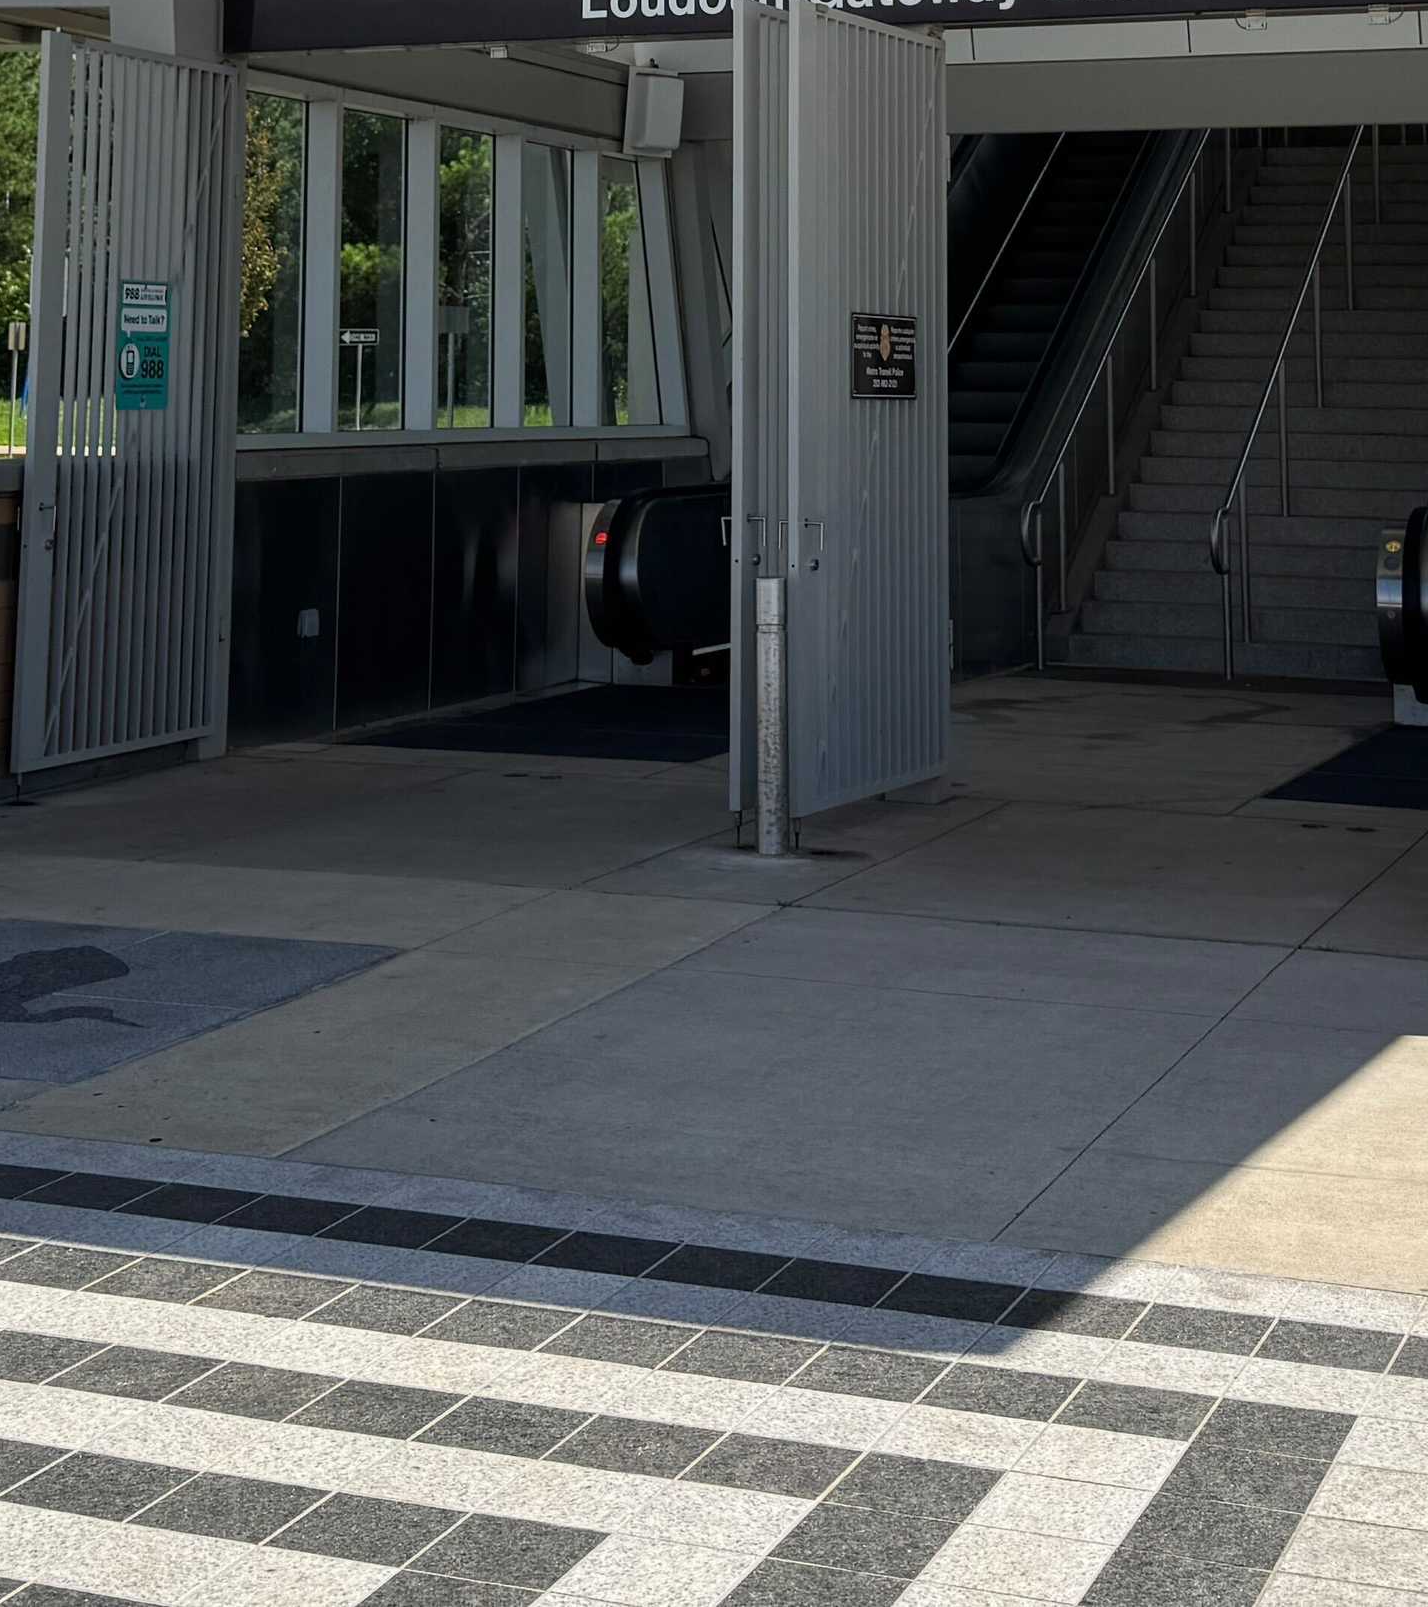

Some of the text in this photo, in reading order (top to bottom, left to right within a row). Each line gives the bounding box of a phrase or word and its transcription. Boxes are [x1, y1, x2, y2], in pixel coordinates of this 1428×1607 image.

[125, 287, 140, 300] 988
[124, 314, 140, 324] Need
[148, 315, 165, 325] Talk?
[144, 345, 161, 357] DIAL
[141, 359, 164, 379] 988
